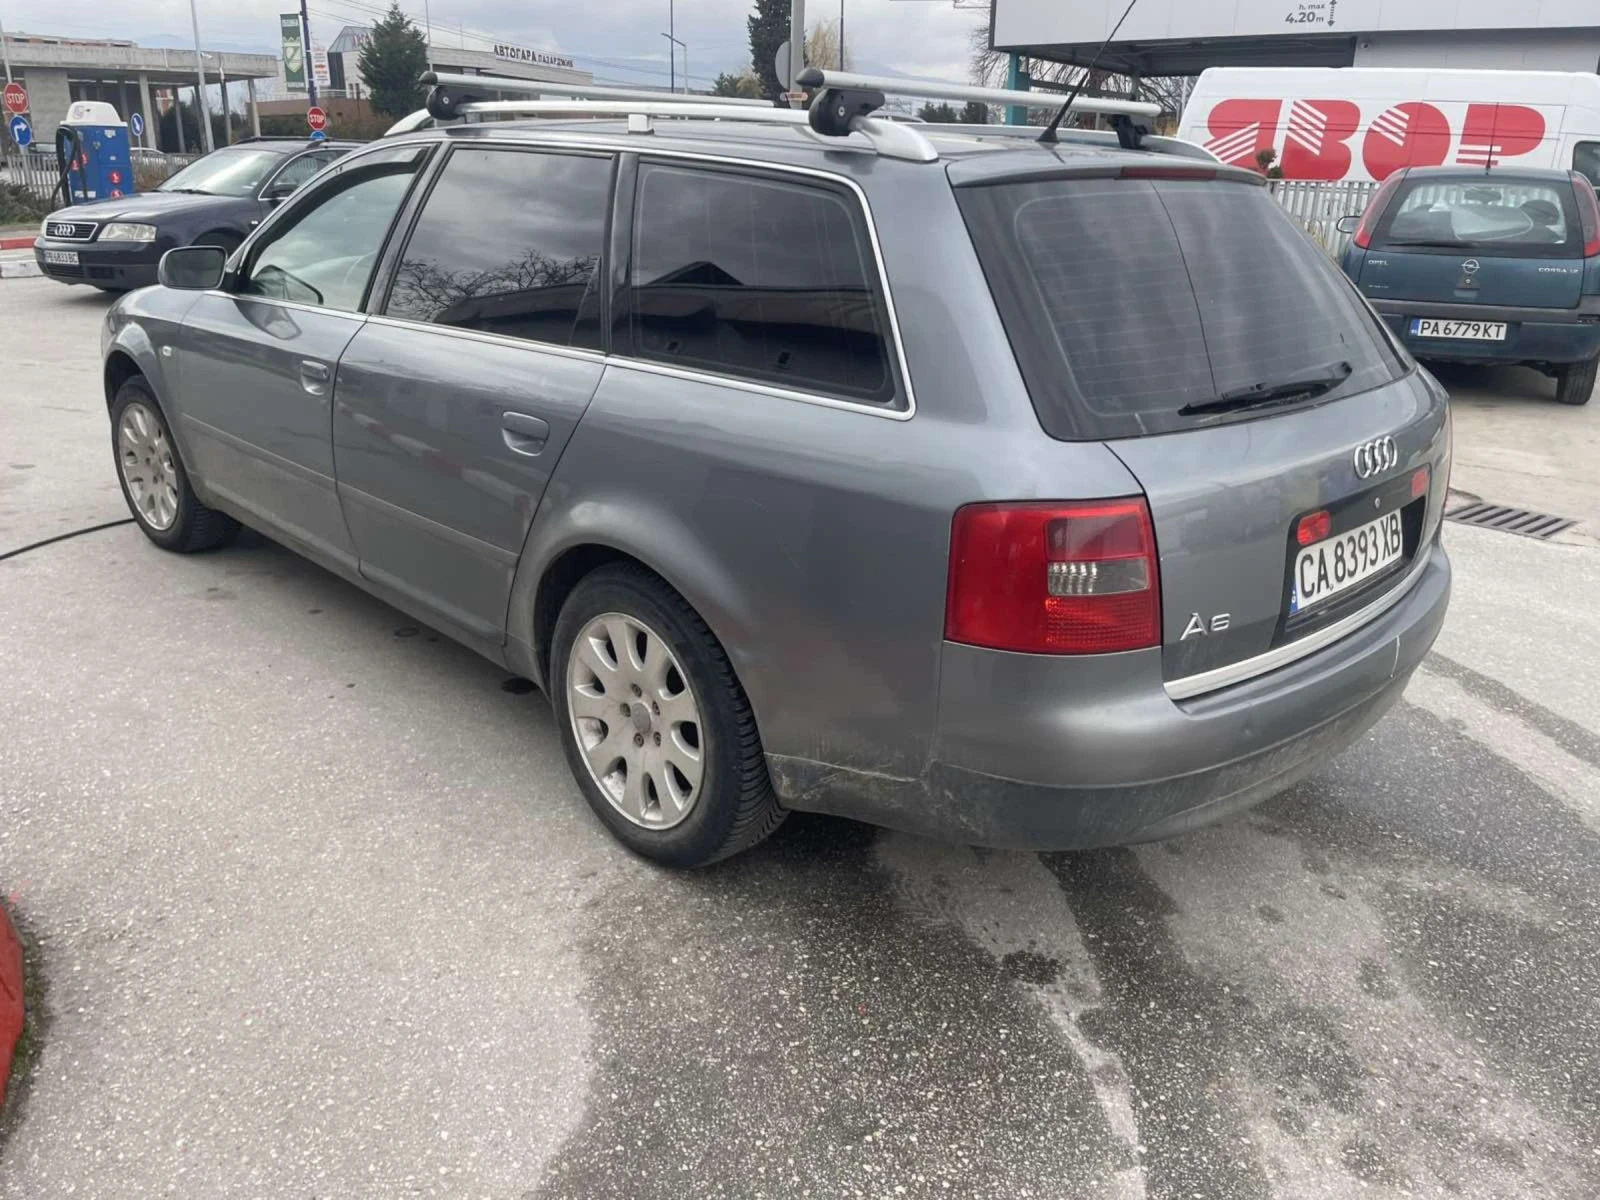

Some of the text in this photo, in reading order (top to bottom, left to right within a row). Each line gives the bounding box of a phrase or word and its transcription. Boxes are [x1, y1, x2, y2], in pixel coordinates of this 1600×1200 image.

[493, 44, 537, 62] АВТОГАРА
[6, 92, 25, 104] STOP
[309, 113, 325, 124] STOP
[1368, 259, 1389, 267] OPEL
[1179, 611, 1230, 641] A6
